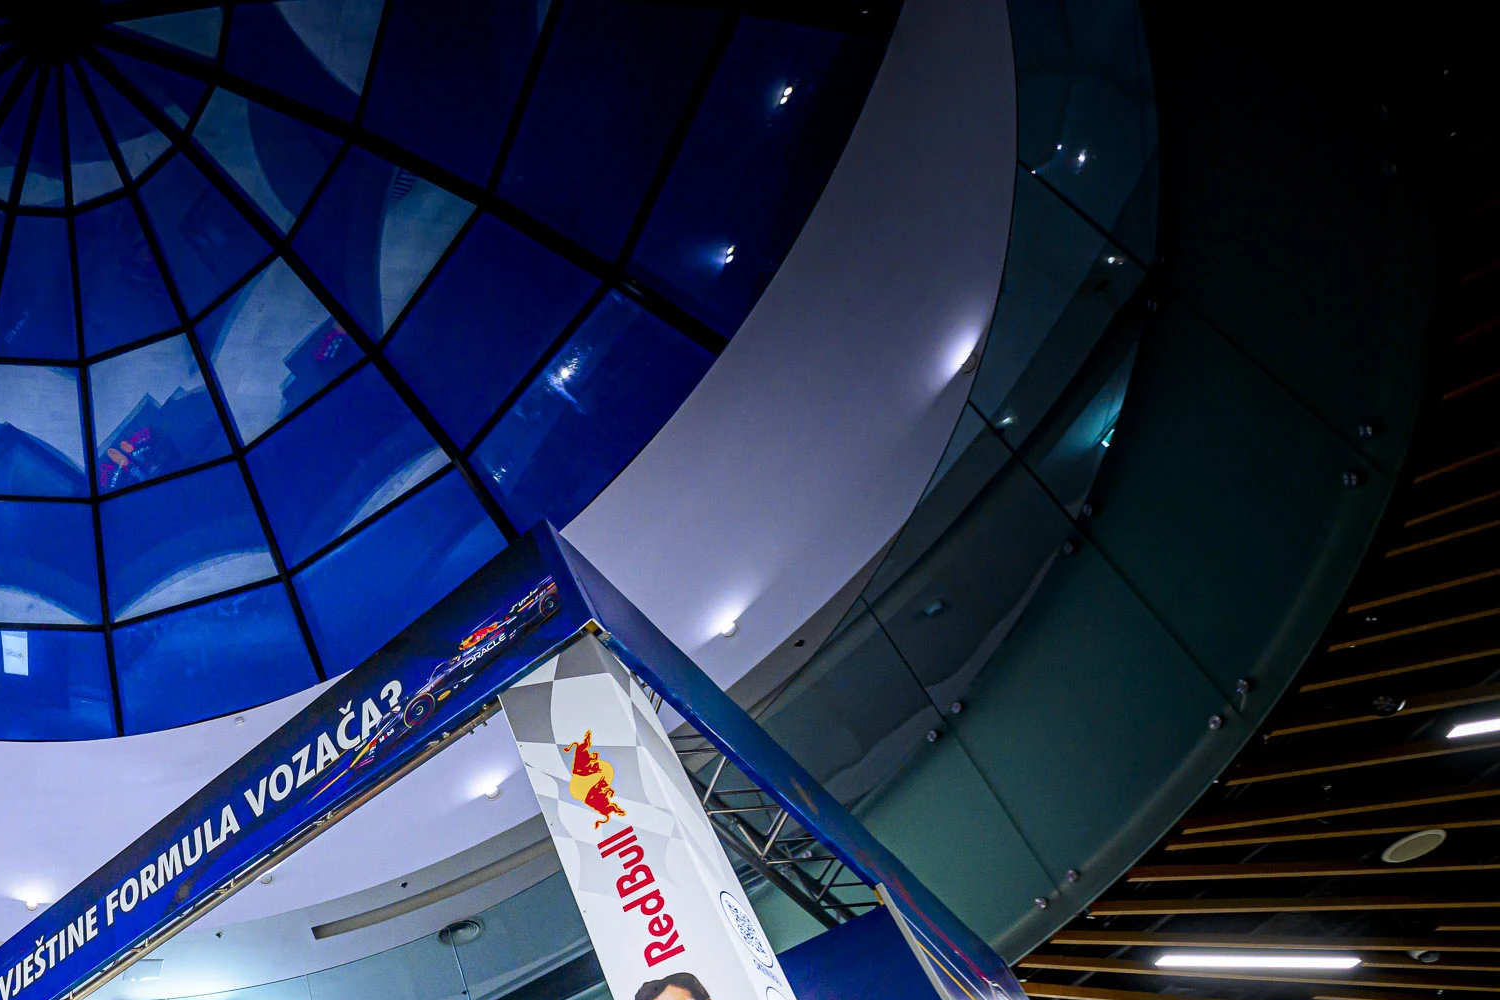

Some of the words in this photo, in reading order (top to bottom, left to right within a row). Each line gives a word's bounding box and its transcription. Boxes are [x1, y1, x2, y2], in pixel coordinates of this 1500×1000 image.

[463, 633, 507, 668] ORACLE
[105, 804, 241, 926] FORMULA
[244, 679, 402, 818] VOZAČA?
